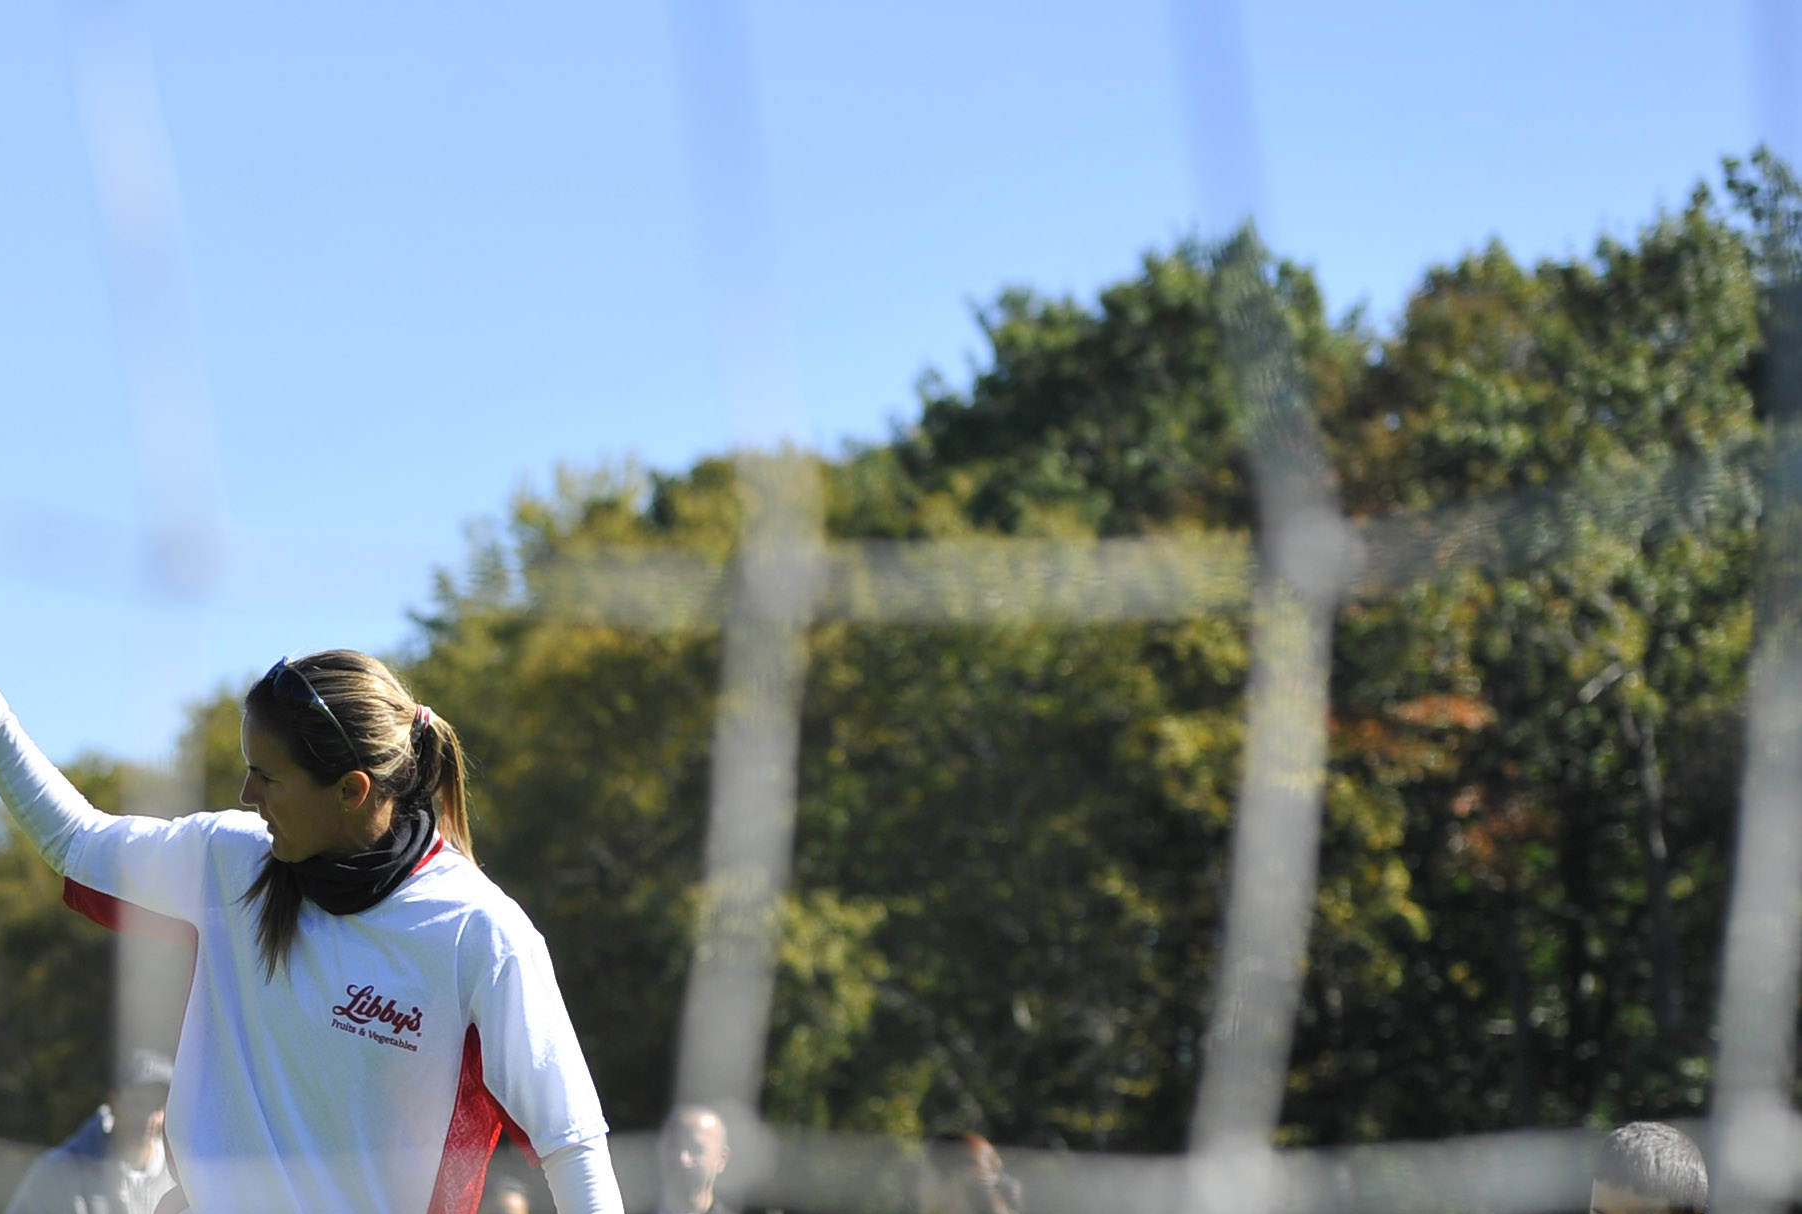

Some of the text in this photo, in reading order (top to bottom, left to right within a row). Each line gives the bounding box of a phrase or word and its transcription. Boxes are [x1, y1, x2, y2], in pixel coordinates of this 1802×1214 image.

[332, 984, 423, 1034] Libby's
[331, 1018, 418, 1052] Fruits & Vegetables
